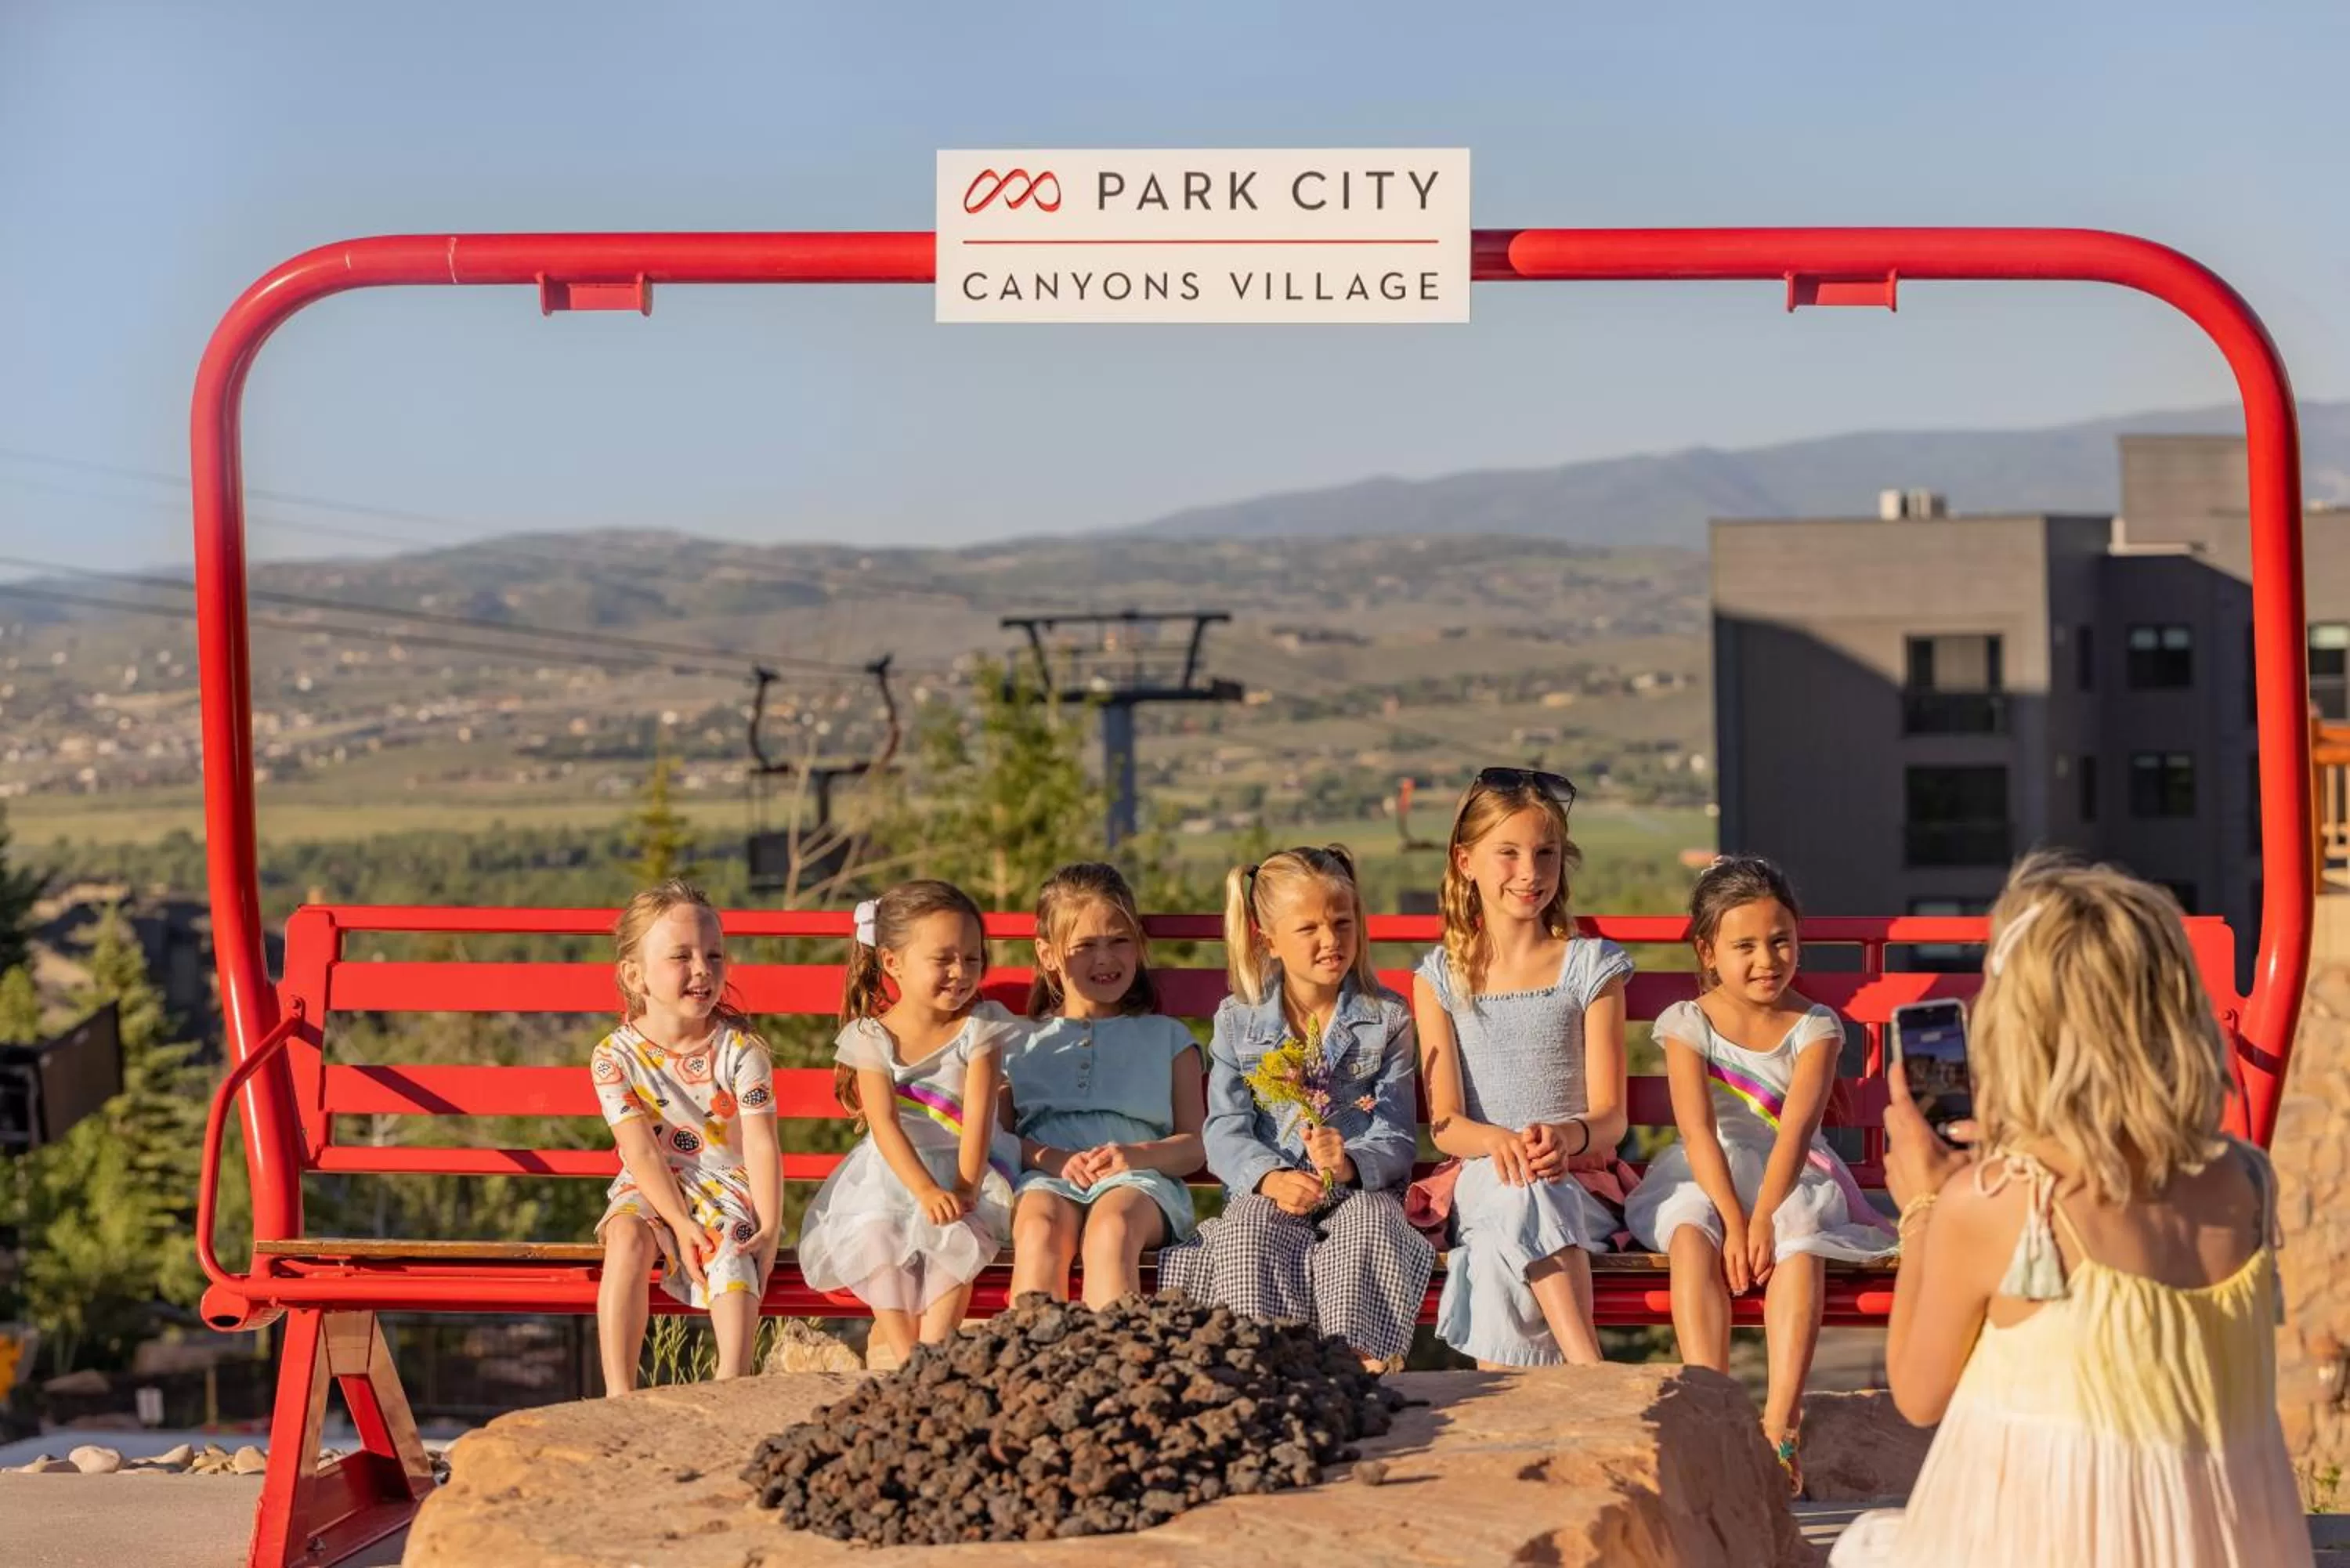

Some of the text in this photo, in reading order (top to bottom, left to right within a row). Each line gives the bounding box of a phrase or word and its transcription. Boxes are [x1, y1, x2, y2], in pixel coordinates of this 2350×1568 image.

[1098, 171, 1439, 211] PARK CITY
[963, 272, 1439, 301] CANYONS VILLAGE
